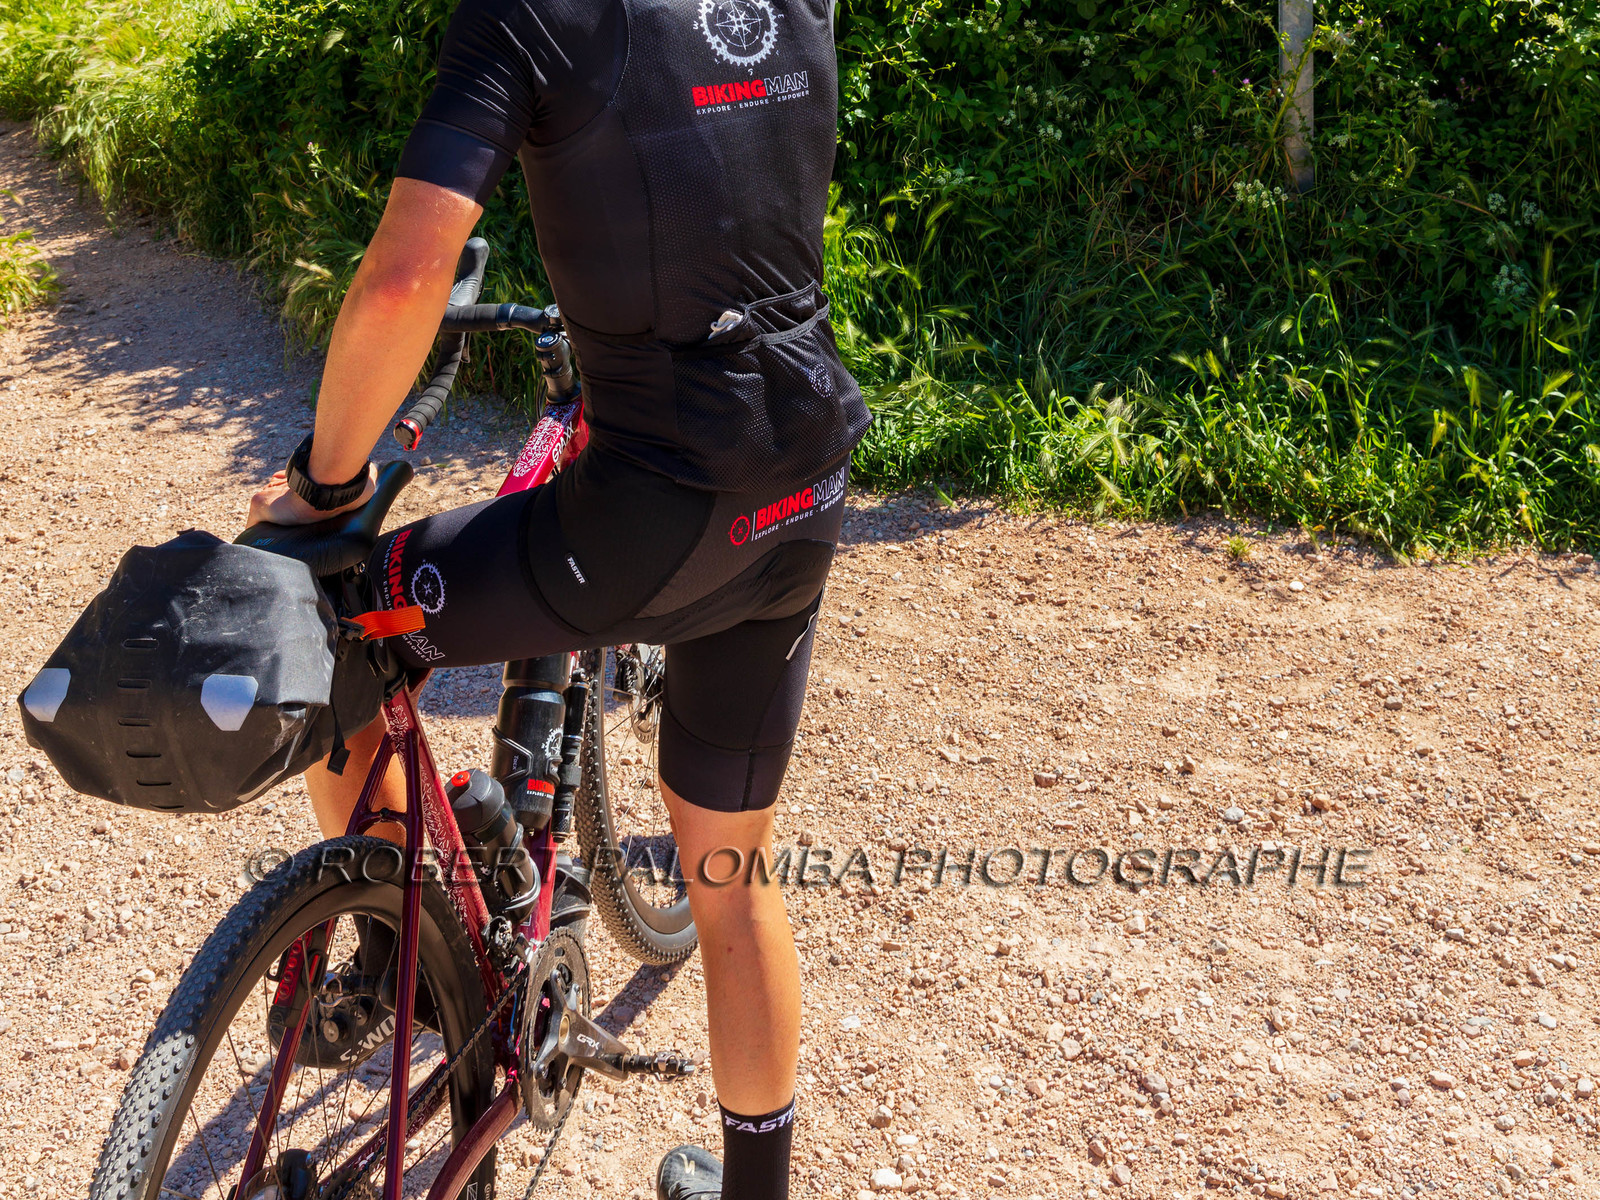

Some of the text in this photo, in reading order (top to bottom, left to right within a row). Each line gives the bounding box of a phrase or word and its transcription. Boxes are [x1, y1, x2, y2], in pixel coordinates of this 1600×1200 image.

[691, 71, 809, 107] BIKINGMAN
[696, 89, 810, 116] EXPLORE ENDURE EMPOWER
[755, 466, 845, 531] BIKINGMAN
[754, 490, 844, 541] EXPLORE ENDURE EMPOWER
[567, 556, 586, 584] FASTER
[382, 580, 395, 612] ENDU
[401, 634, 431, 662] MPOWER
[576, 1033, 600, 1050] GRX
[724, 1103, 796, 1133] FASTE
